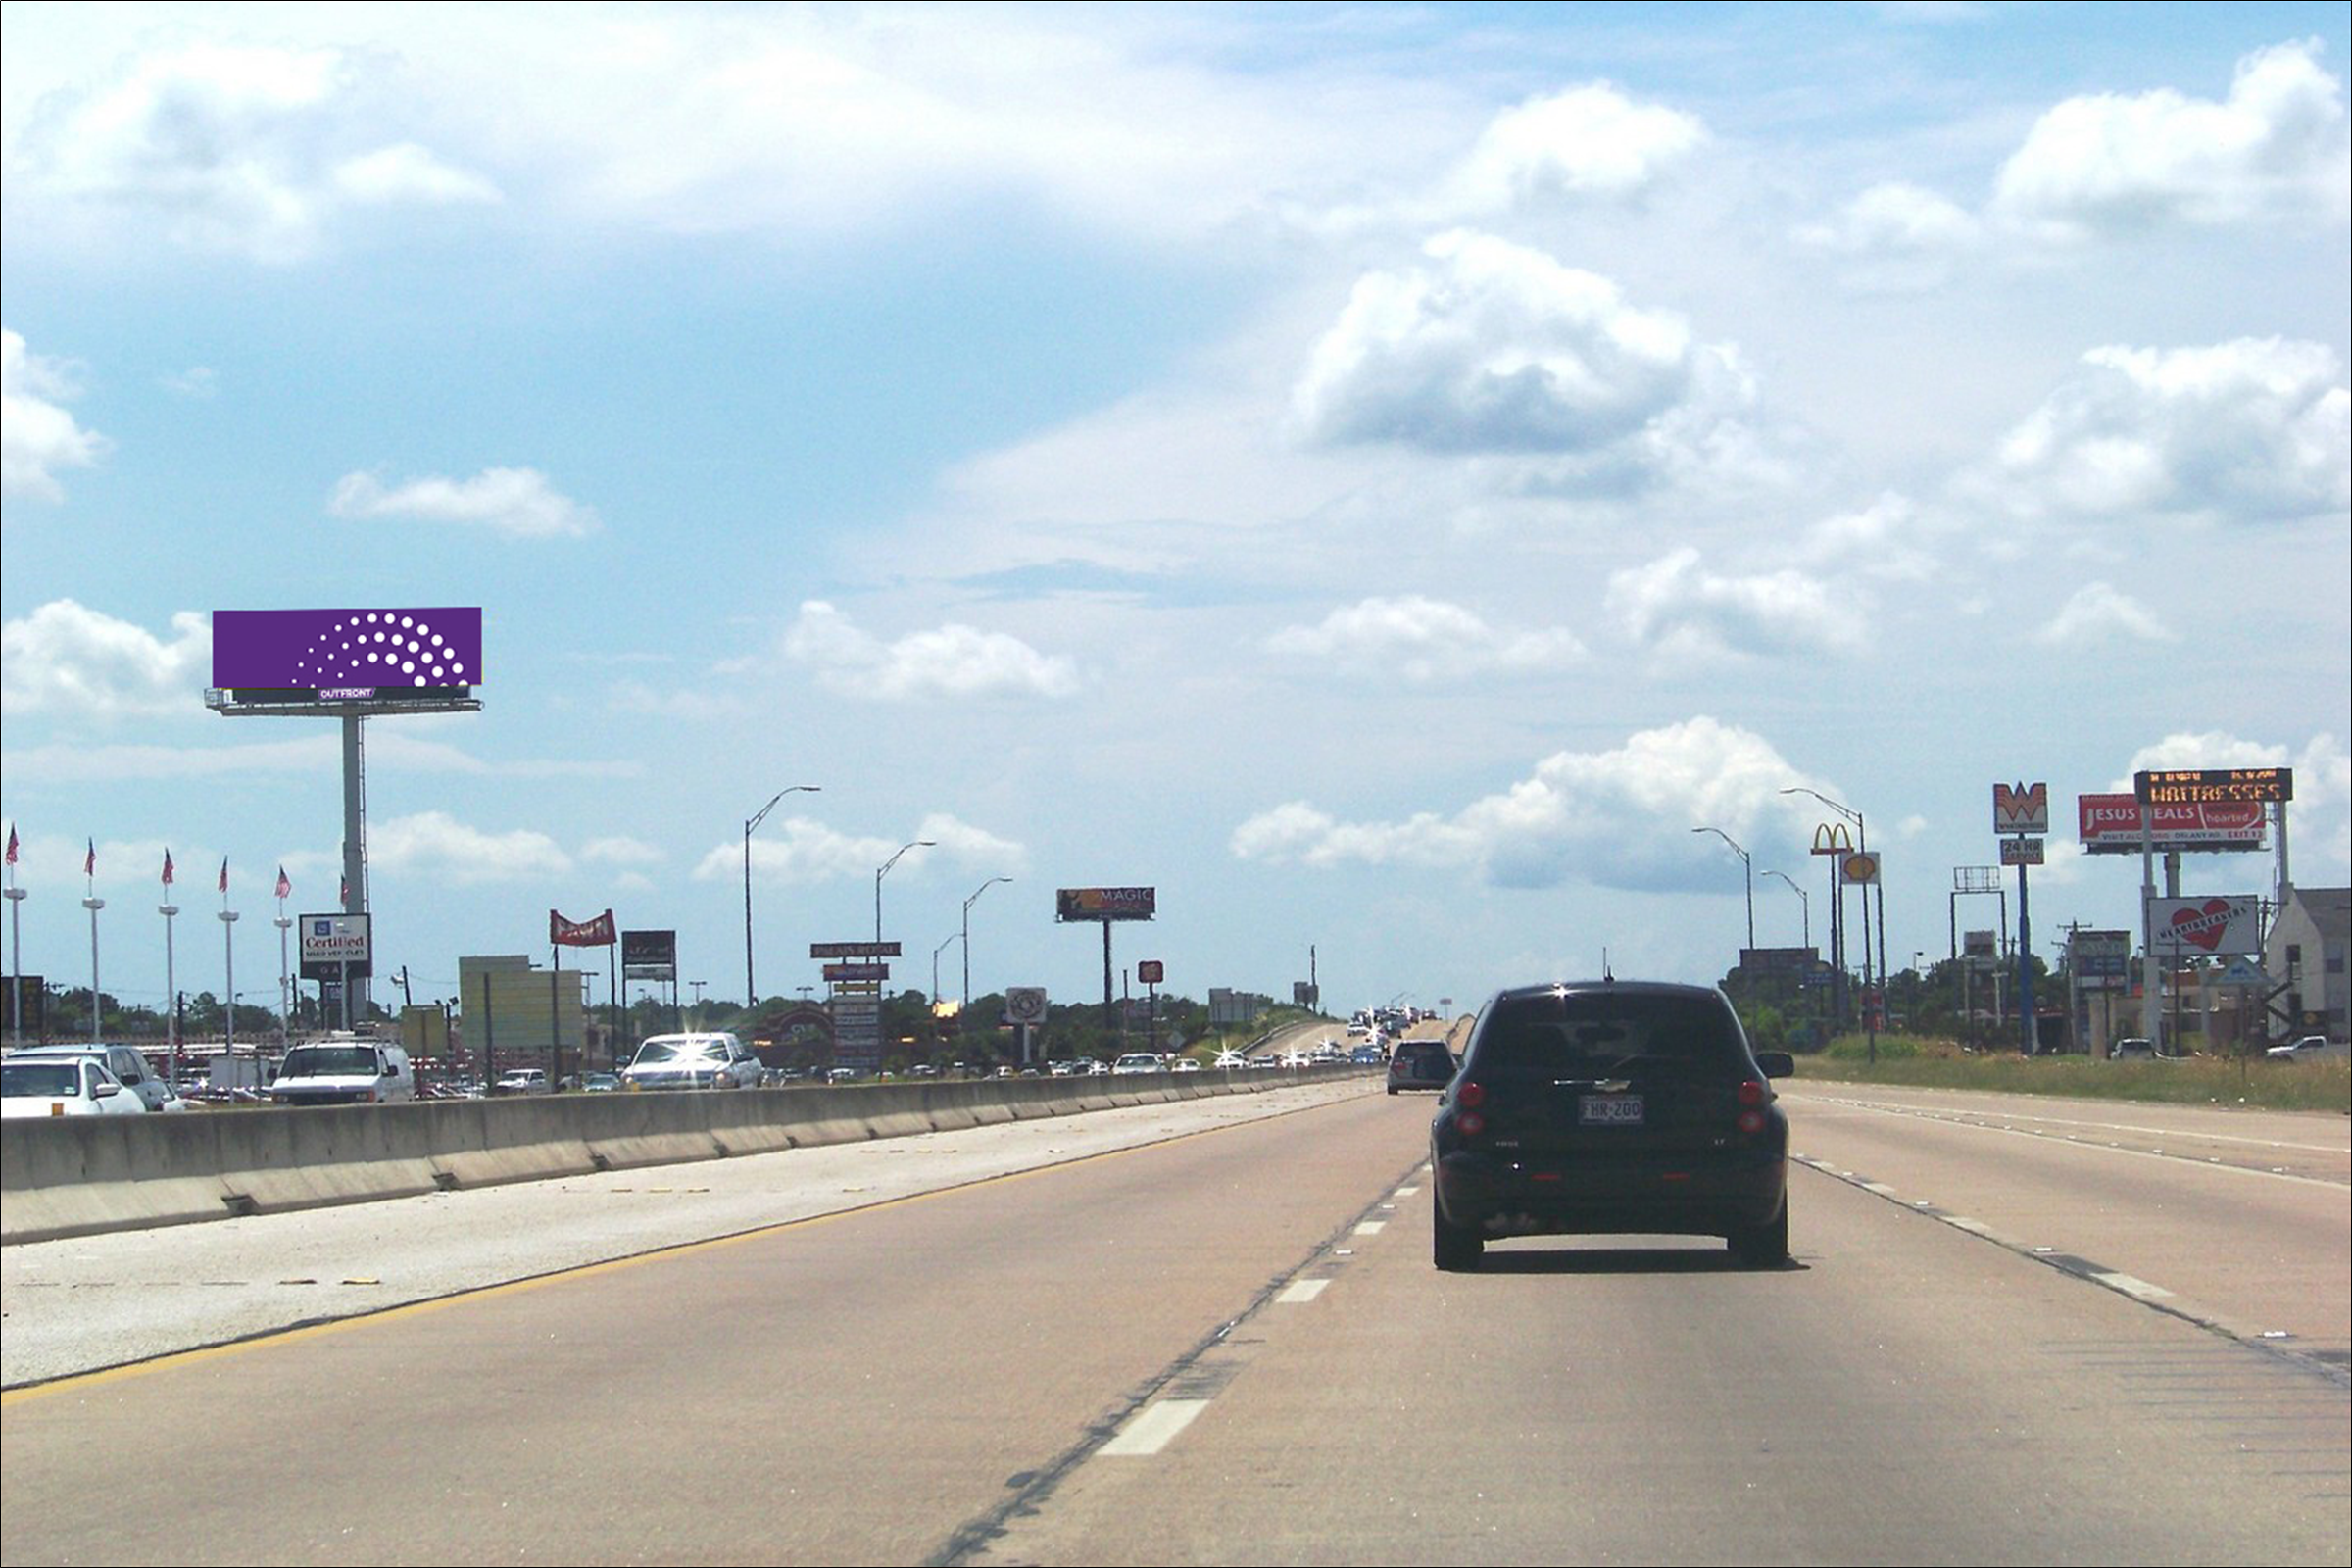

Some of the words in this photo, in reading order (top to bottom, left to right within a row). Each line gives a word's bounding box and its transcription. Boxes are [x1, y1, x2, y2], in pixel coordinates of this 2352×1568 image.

[320, 689, 371, 698] OUTFRONT
[2086, 808, 2135, 829] JESUS
[2004, 841, 2021, 852] 24
[2024, 840, 2040, 851] HR
[1101, 889, 1152, 902] MAGIC
[306, 936, 364, 949] Certified
